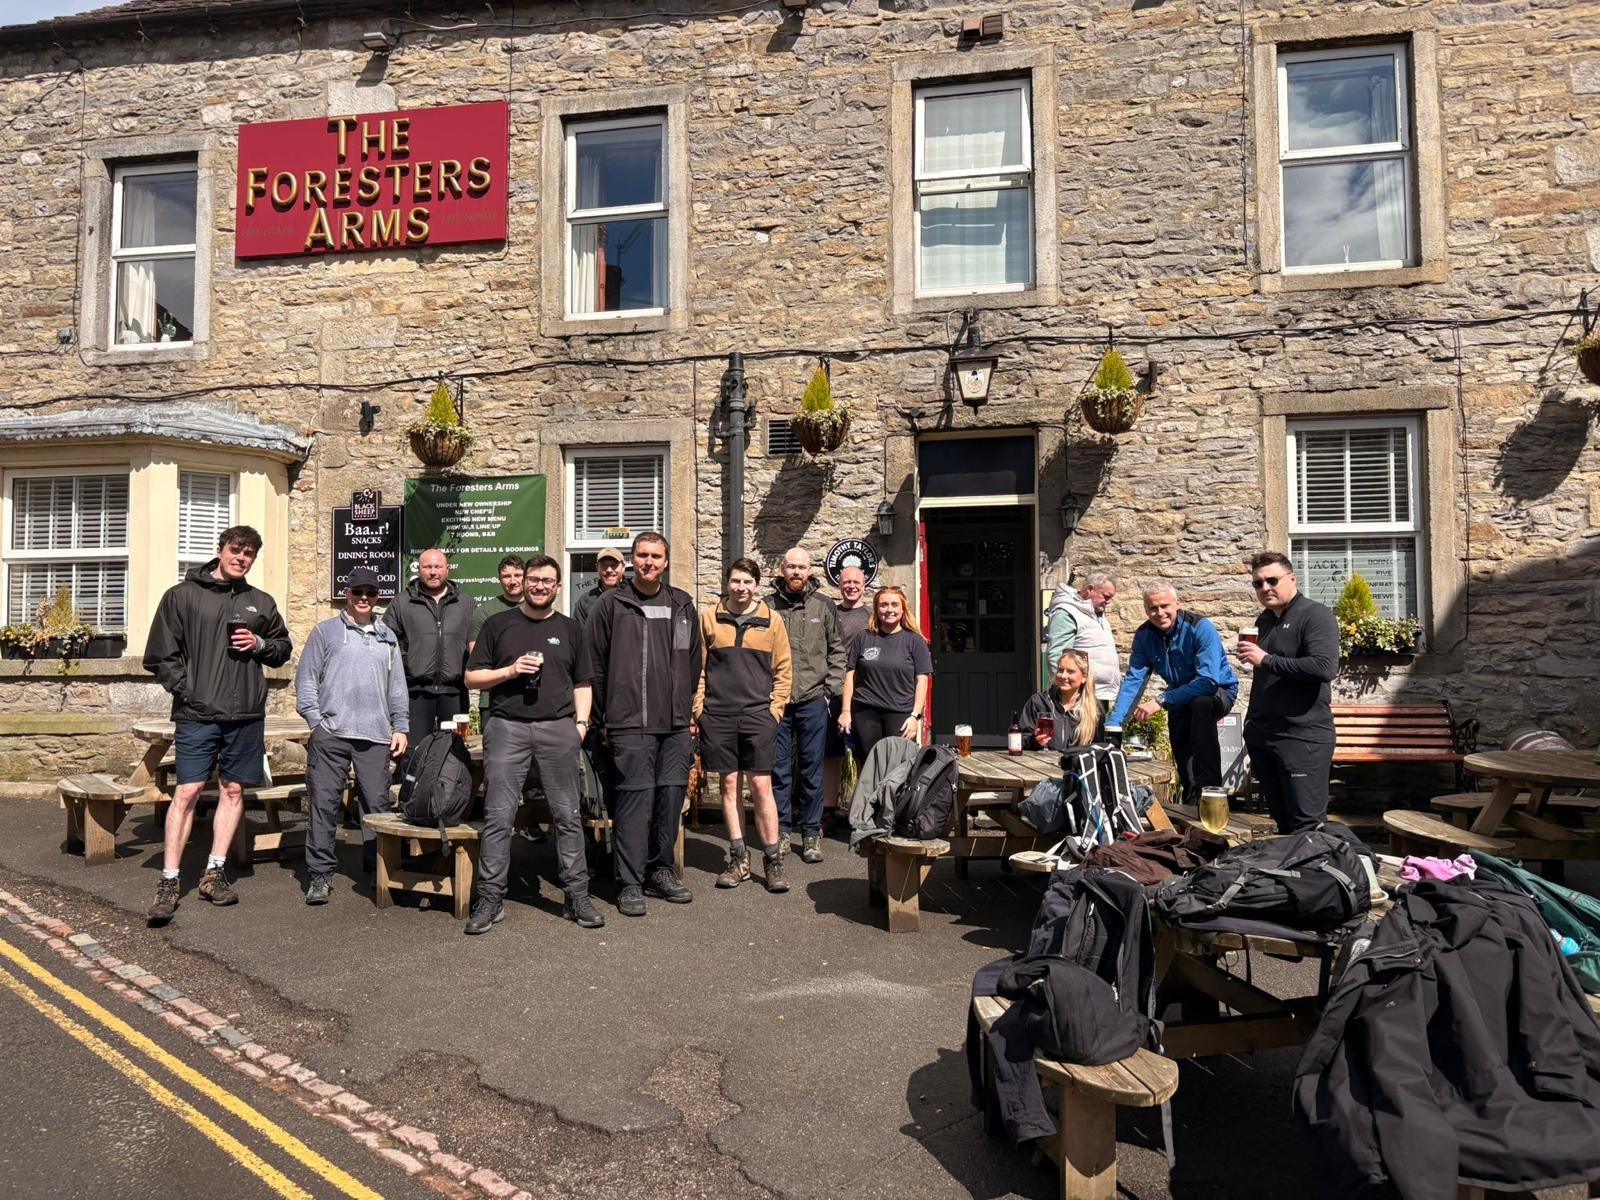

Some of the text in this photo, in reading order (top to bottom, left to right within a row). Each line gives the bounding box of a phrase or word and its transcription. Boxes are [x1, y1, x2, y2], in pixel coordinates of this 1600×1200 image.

[327, 115, 410, 163] THE
[246, 157, 492, 213] FORESTERS
[304, 207, 430, 251] ARMS
[431, 482, 520, 492] The Foresters Arms
[351, 537, 382, 545] SNACKS
[338, 551, 395, 560] DINING ROOM
[830, 542, 851, 568] TIMOTHY
